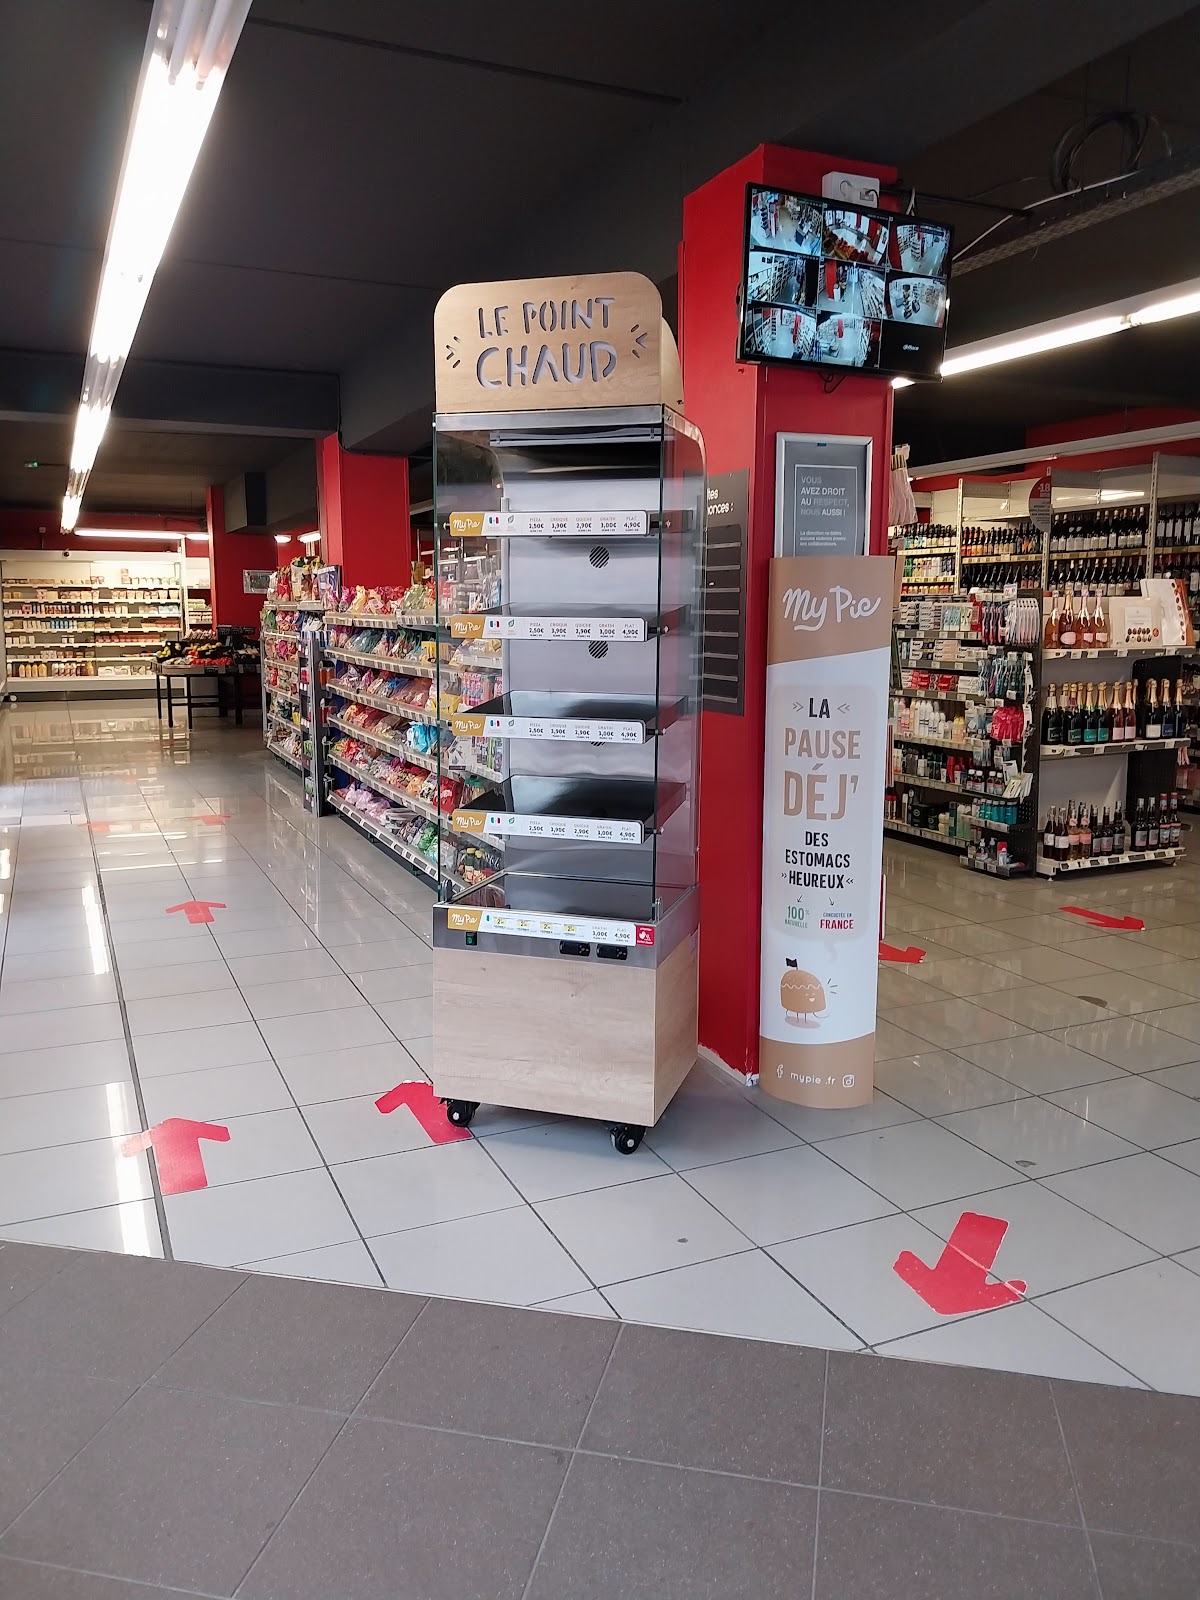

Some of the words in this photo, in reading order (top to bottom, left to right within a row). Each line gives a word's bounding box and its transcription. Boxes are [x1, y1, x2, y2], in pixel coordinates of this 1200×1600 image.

[478, 305, 509, 338] LE
[522, 297, 616, 334] POINT
[476, 340, 617, 389] CHAUD
[801, 476, 822, 484] VOUS
[800, 487, 820, 495] AVEZ
[821, 487, 845, 496] DROIT
[783, 587, 828, 630] My
[829, 585, 881, 622] Pie
[808, 697, 830, 719] LA
[784, 727, 861, 760] PAUSE
[805, 831, 829, 847] DES
[785, 848, 851, 868] ESTOMACS
[788, 869, 844, 889] HEUREUX
[820, 919, 854, 930] FRANCE
